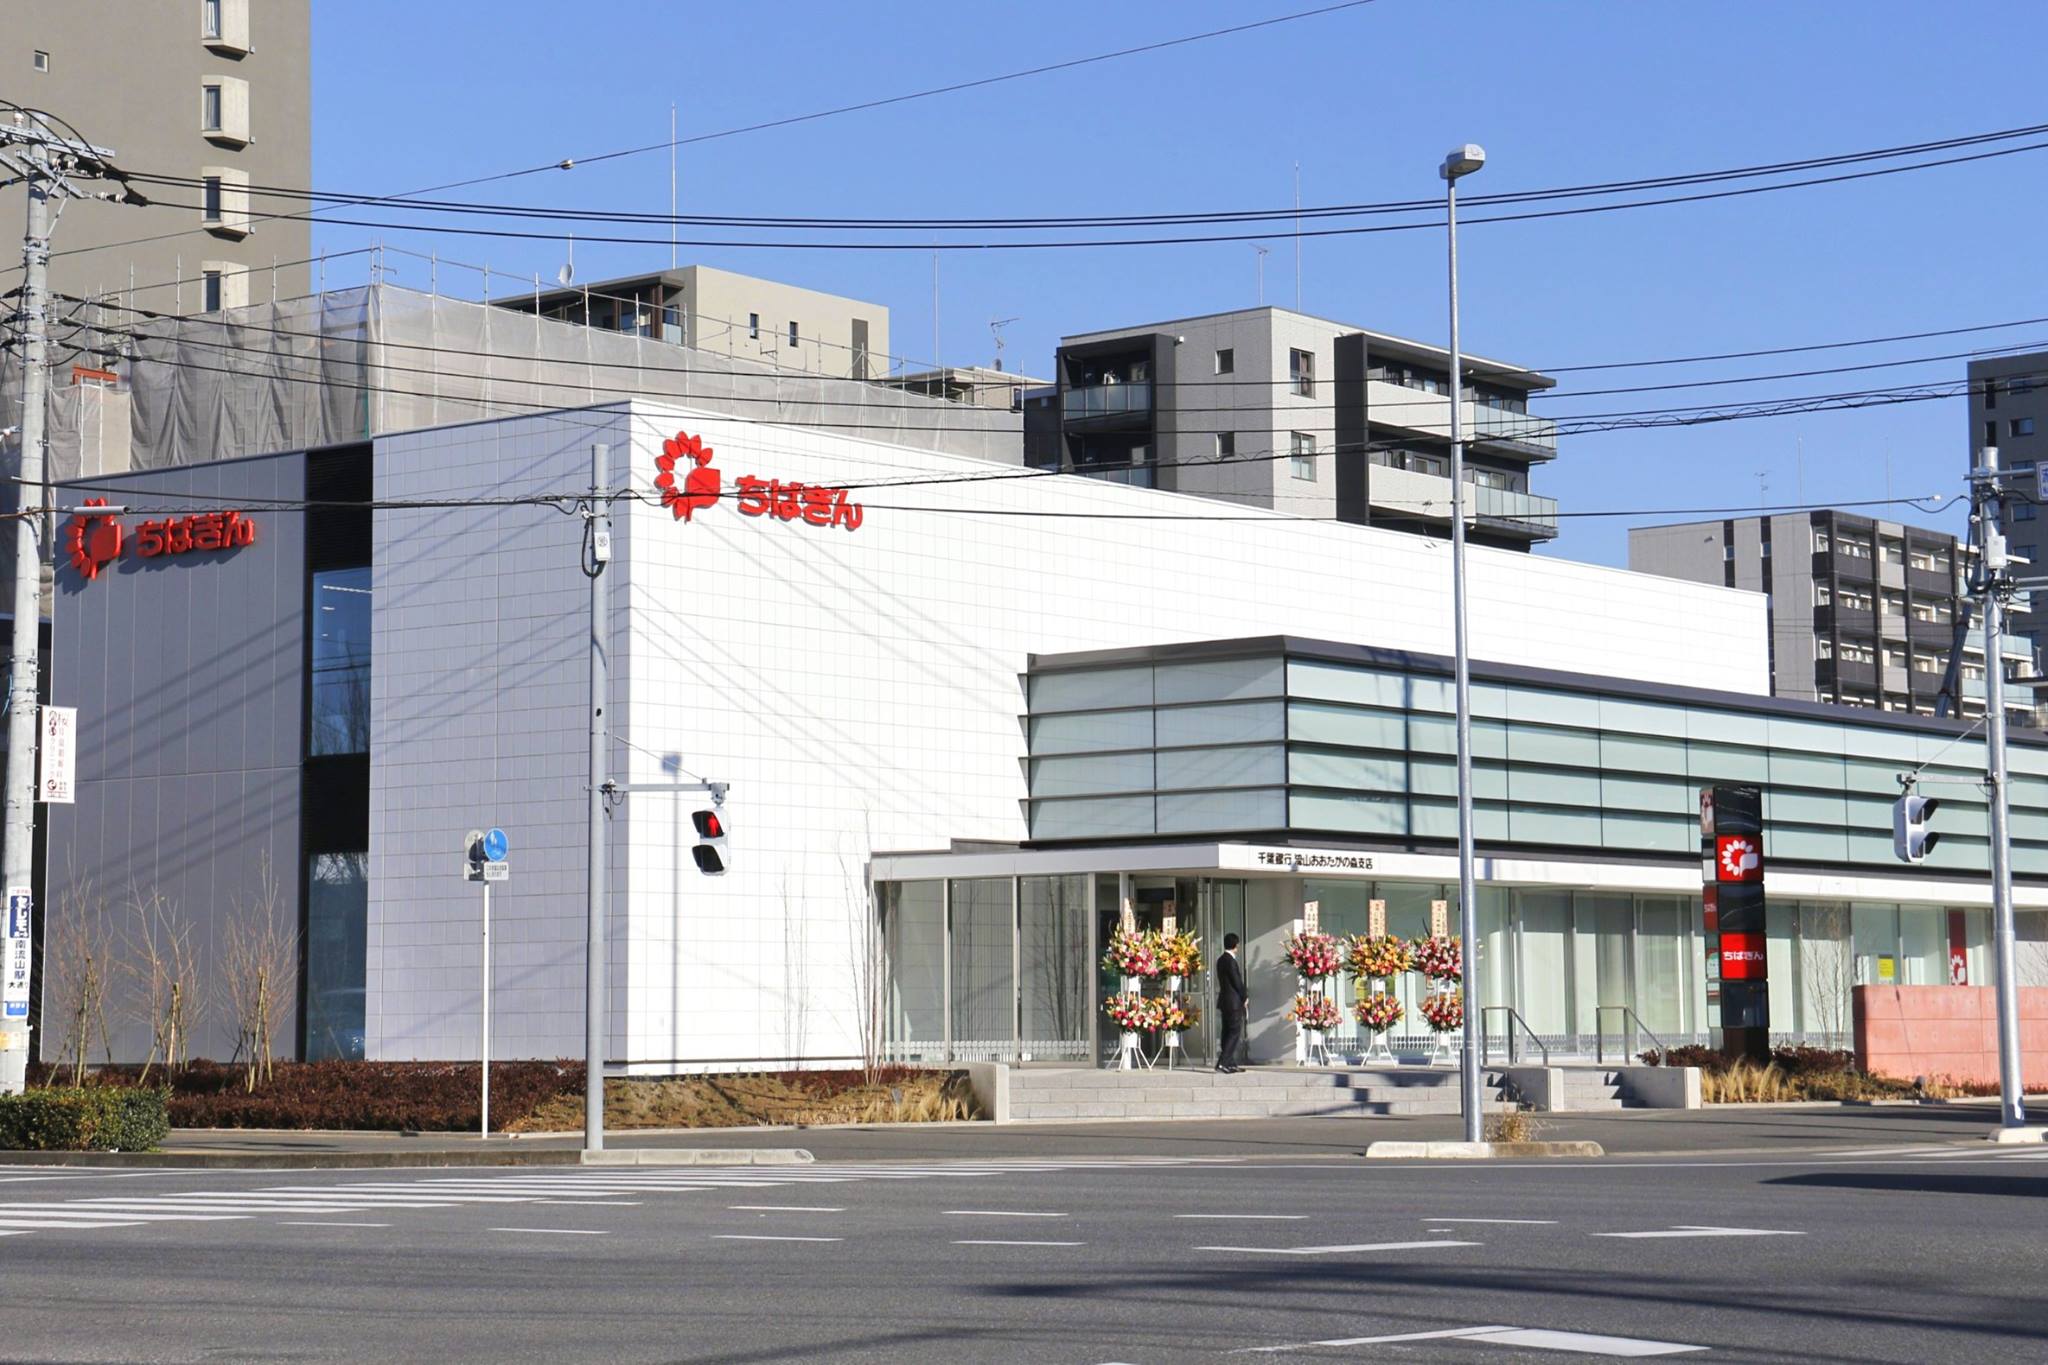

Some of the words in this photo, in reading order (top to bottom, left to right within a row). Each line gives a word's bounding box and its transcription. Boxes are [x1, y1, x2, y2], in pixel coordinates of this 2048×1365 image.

[734, 474, 864, 532] ちばぎん
[135, 510, 255, 558] ちばぎん
[1257, 851, 1292, 865] 千葉銀行
[1294, 853, 1374, 870] 流山おおたかの森支店
[15, 940, 26, 979] 南流山駅
[1722, 951, 1763, 960] ちばぎん
